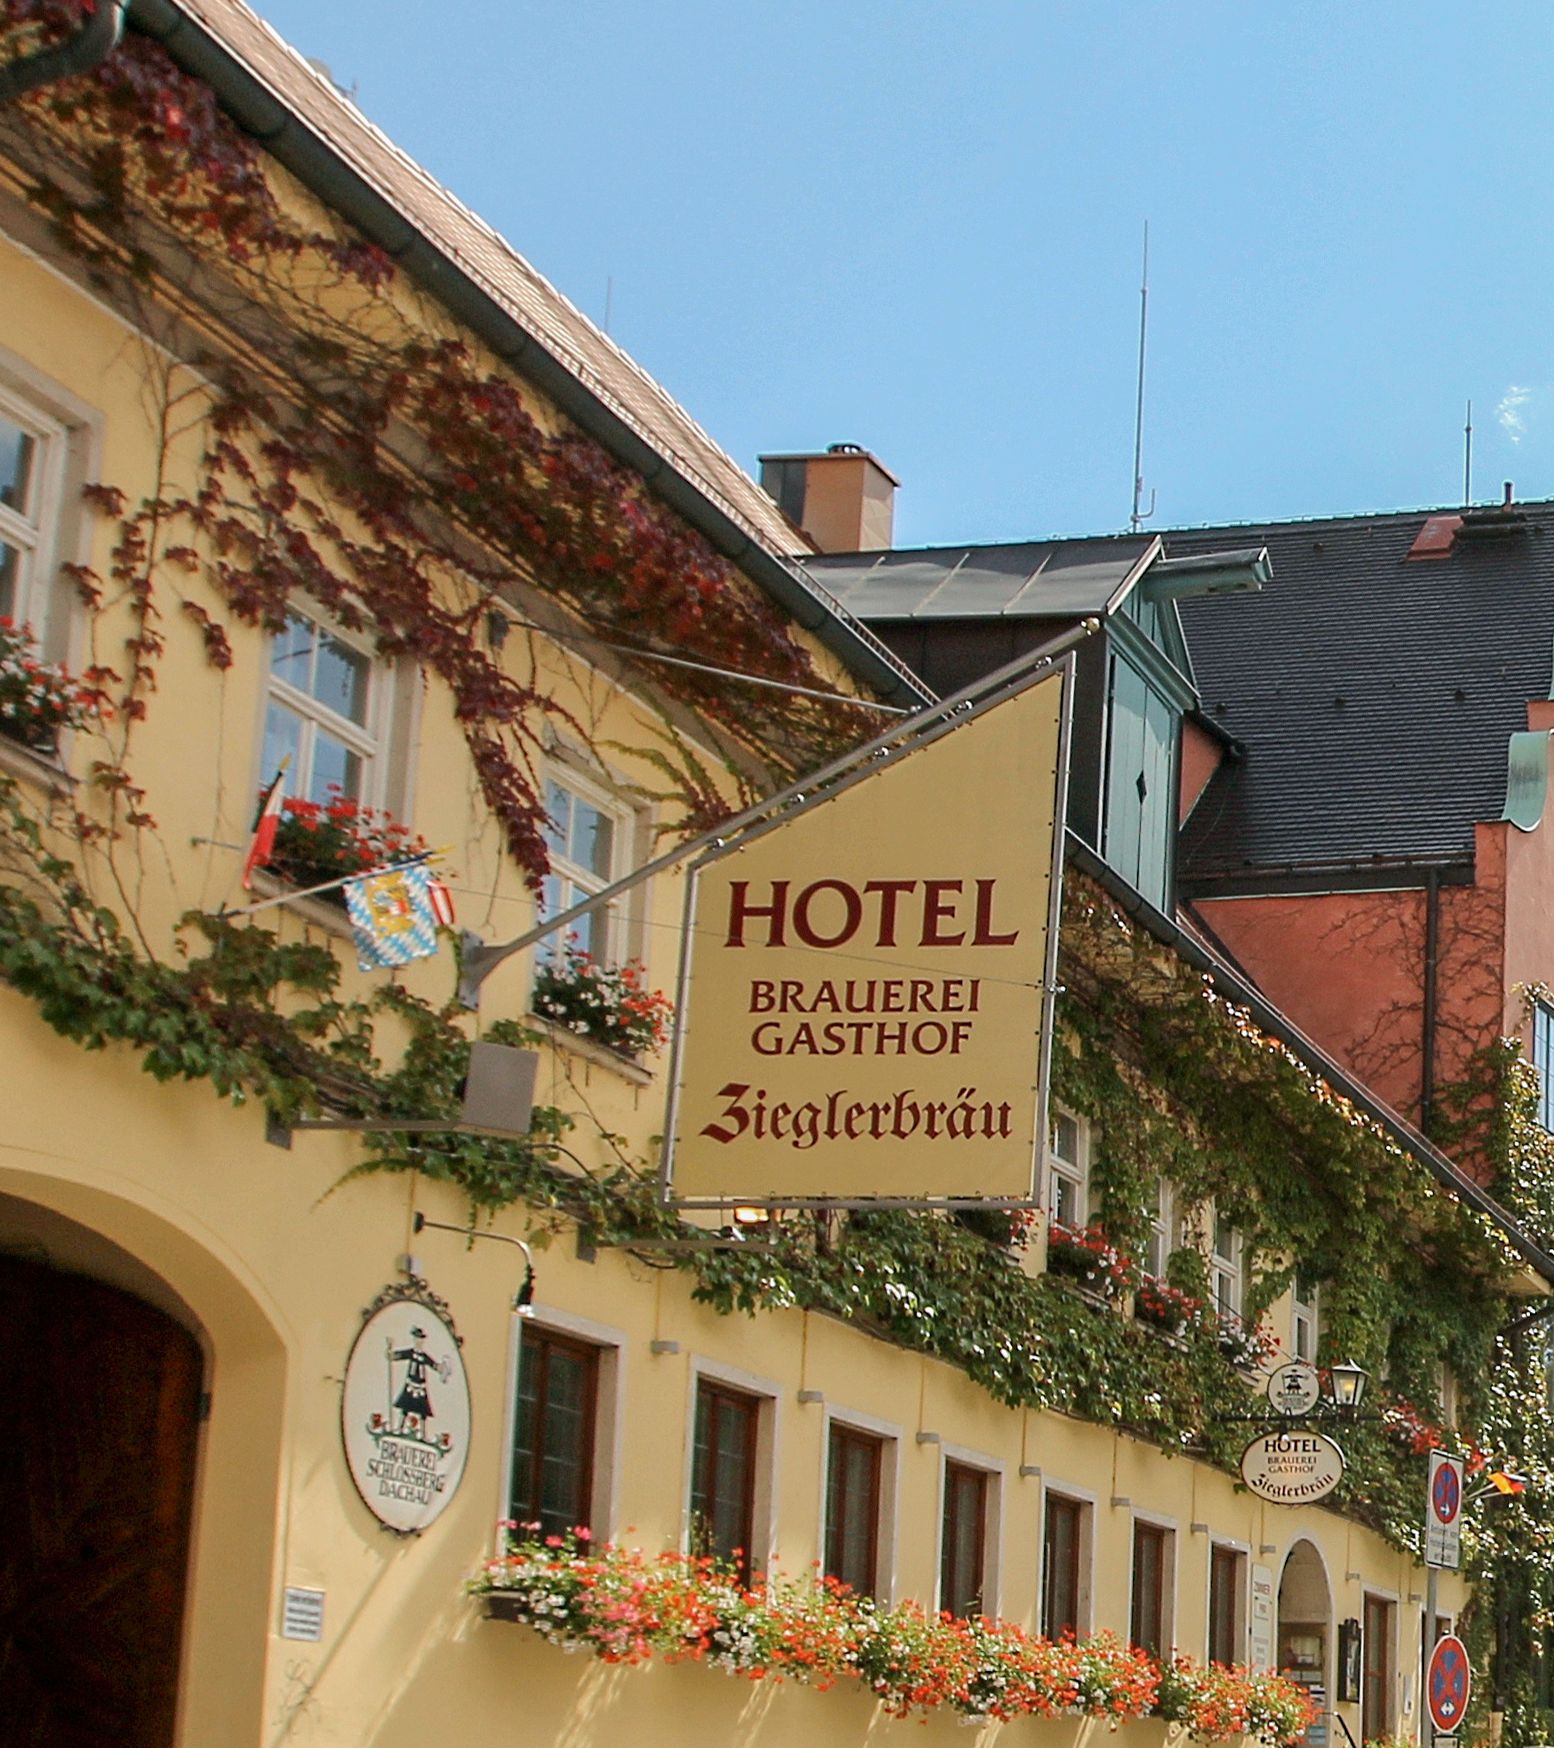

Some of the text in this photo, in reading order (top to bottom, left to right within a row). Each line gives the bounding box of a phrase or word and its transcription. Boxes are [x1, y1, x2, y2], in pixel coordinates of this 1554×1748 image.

[724, 879, 1019, 948] HOTEL
[749, 979, 980, 1013] BRAUEREI
[751, 1021, 973, 1055] GASTHOF
[700, 1082, 1012, 1149] Zieglerbräu
[380, 1440, 436, 1472] BRAUEREI
[1264, 1439, 1321, 1453] HOTEL
[1267, 1456, 1317, 1465] BRAUEREI
[366, 1458, 445, 1492] SCHLOSSBERG
[1251, 1473, 1334, 1497] Zieglerbräu
[1268, 1465, 1314, 1474] GASTHOF
[379, 1479, 431, 1505] DACHAU
